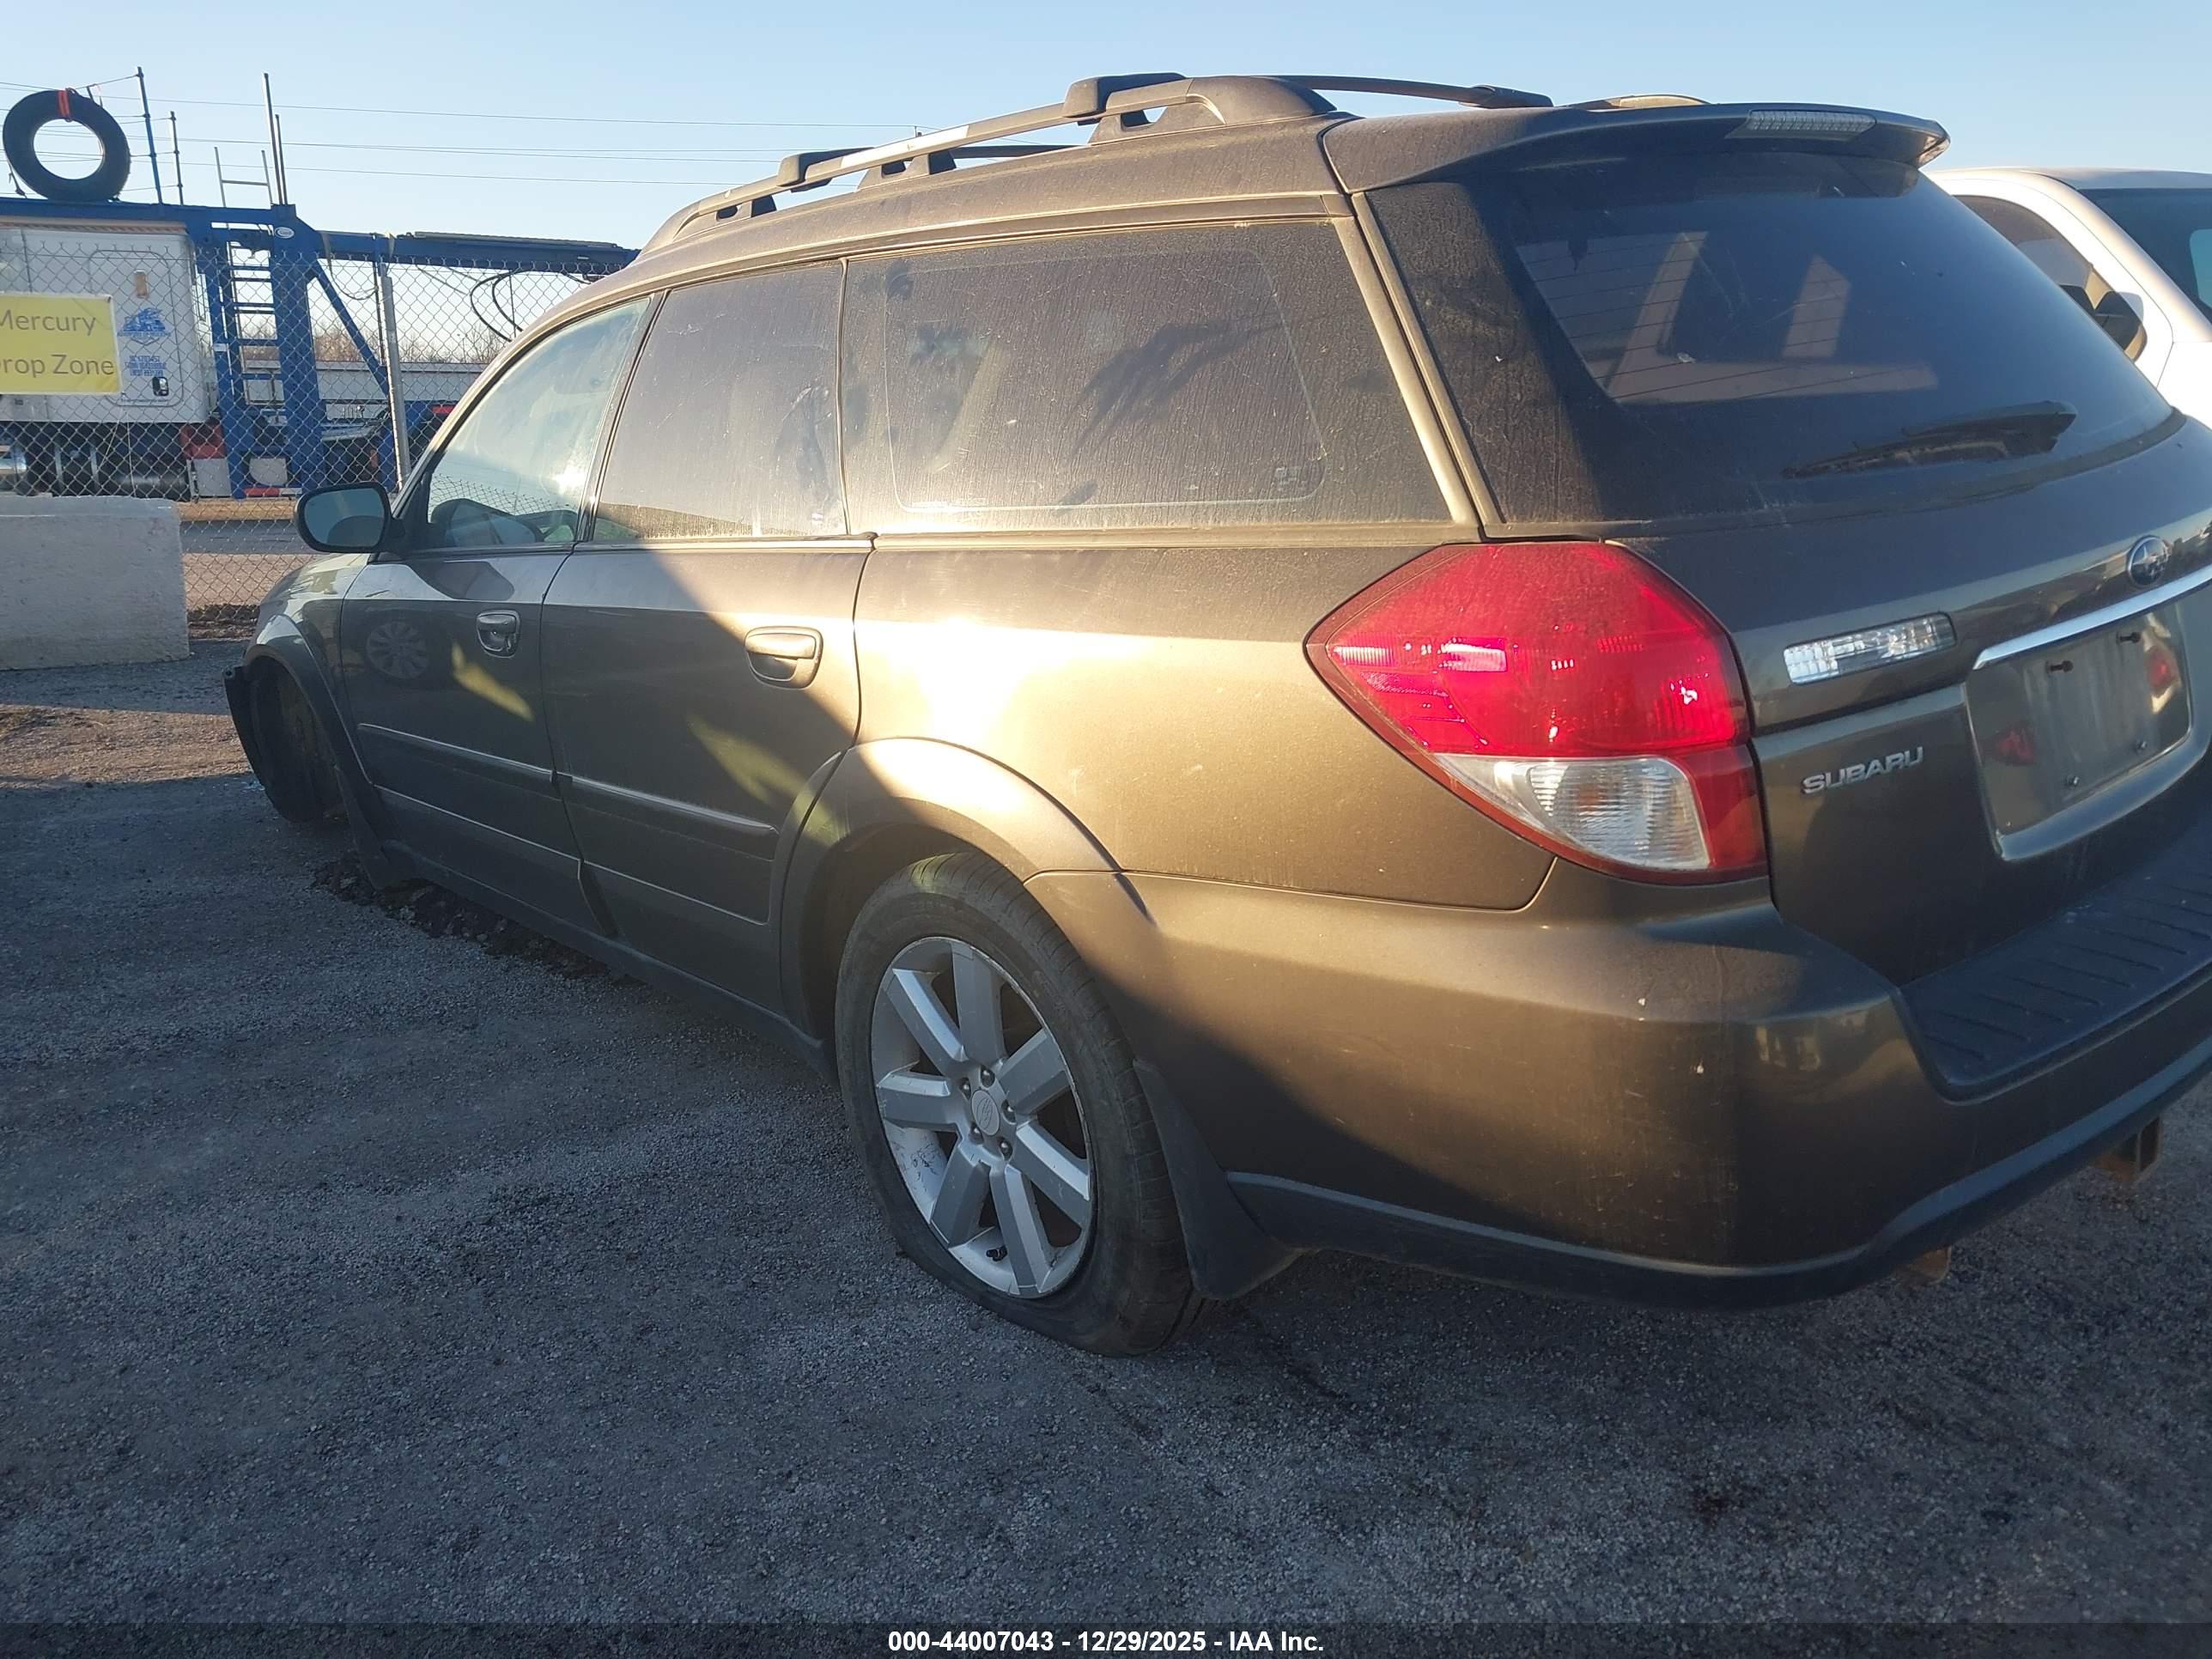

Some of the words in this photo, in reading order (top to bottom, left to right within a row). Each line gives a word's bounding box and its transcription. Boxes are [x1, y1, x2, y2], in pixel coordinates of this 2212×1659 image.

[0, 358, 46, 379] rop
[51, 354, 115, 375] Zone
[1802, 746, 1924, 794] SUBARU
